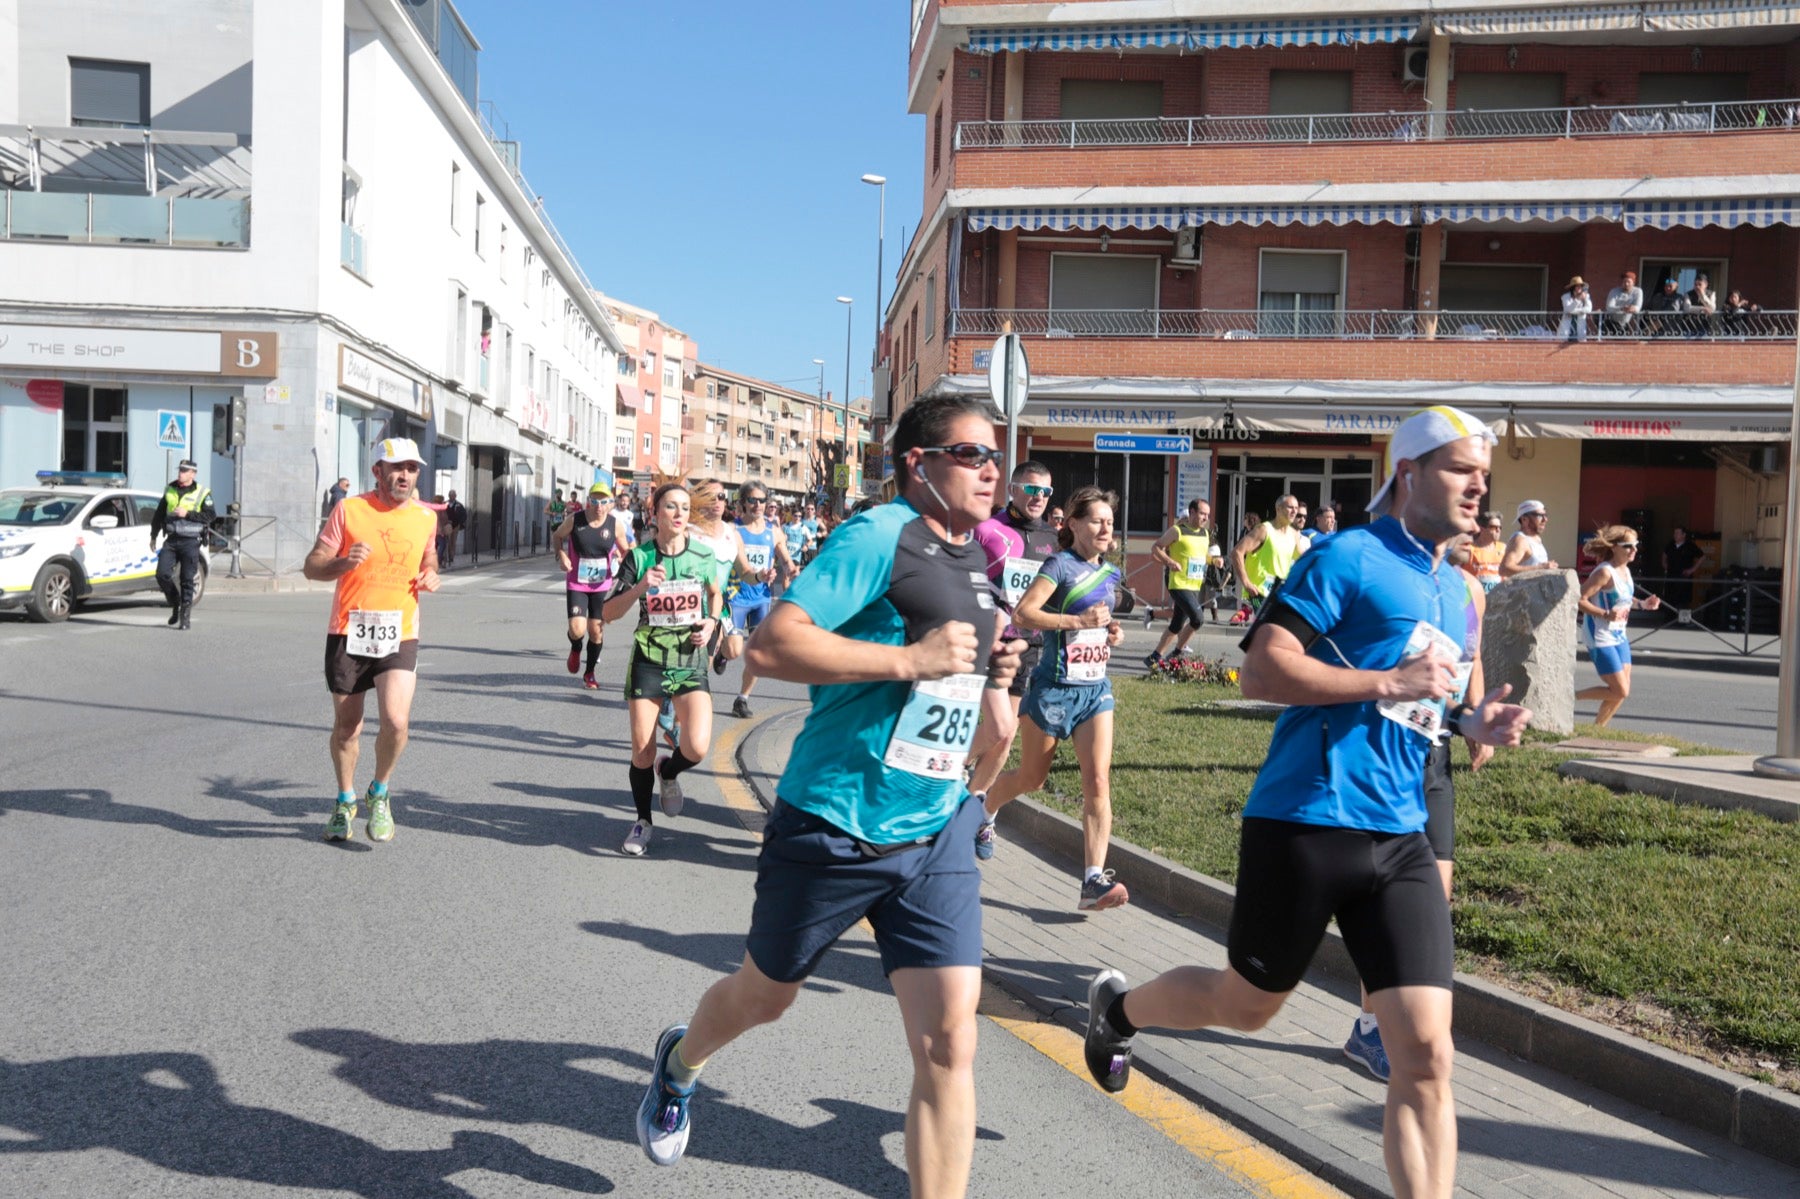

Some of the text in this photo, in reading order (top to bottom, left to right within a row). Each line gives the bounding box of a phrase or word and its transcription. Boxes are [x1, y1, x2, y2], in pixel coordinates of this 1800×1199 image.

[27, 342, 125, 357] THE SHOP
[236, 338, 261, 368] B
[1047, 408, 1177, 424] RESTAURANTE
[1326, 413, 1402, 429] PARADA
[1097, 438, 1137, 448] Granada
[650, 594, 699, 612] 2029
[356, 623, 397, 641] 3133
[917, 704, 973, 746] 285
